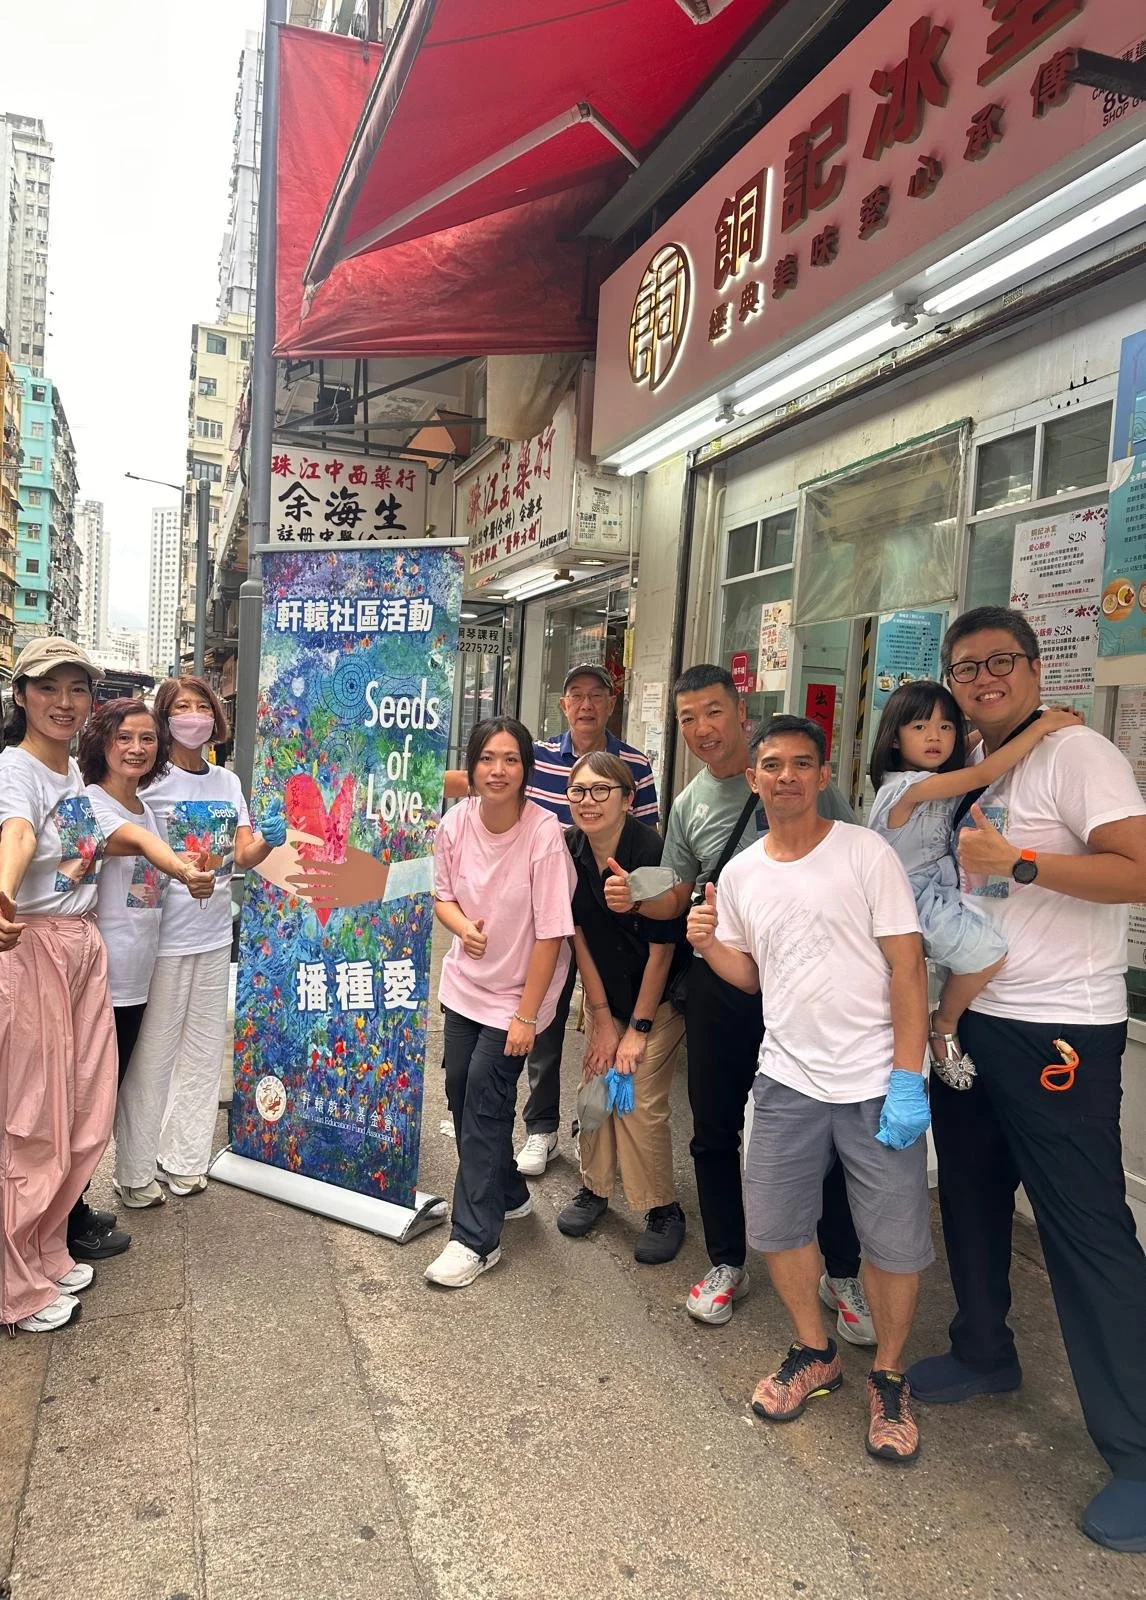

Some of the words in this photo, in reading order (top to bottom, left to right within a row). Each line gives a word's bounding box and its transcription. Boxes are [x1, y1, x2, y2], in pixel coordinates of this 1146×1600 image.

[1102, 101, 1129, 127] SHOP
[270, 454, 416, 492] 珠江中西藥行
[278, 481, 407, 530] 余海生
[1068, 530, 1087, 544] $28
[276, 598, 433, 633] 軒轅社區活動
[1054, 624, 1072, 637] $28
[365, 678, 440, 730] Seeds
[387, 734, 413, 781] of
[207, 805, 236, 819] Seeds
[366, 773, 423, 824] Love
[220, 818, 229, 834] of
[297, 959, 418, 1011] 播種愛
[325, 1115, 352, 1132] Education
[352, 1123, 366, 1136] Fund
[366, 1127, 397, 1144] Association
